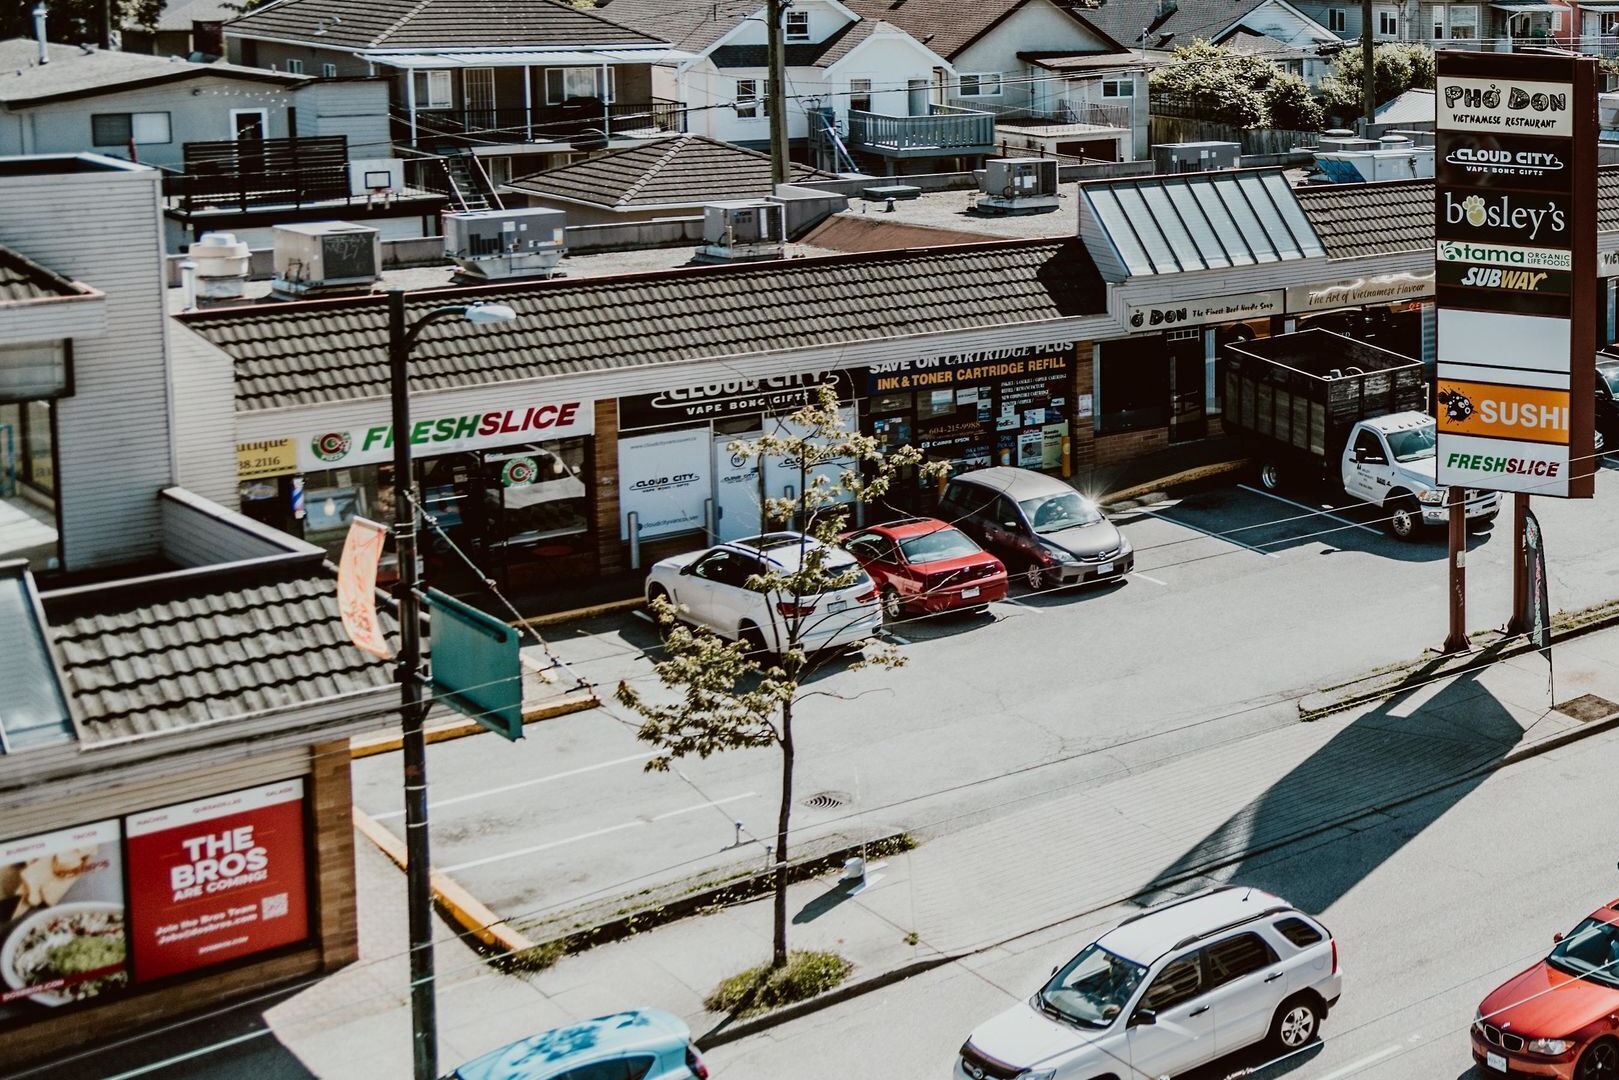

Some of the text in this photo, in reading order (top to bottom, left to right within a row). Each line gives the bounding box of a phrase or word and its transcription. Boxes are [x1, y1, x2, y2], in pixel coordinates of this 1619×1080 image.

[1507, 87, 1566, 112] DON
[1452, 114, 1557, 129] VIETNAMESE RESTAURANT
[1457, 149, 1554, 166] CLOUD CITY
[1466, 166, 1488, 174] VAPE
[1445, 192, 1566, 240] bosley's
[1464, 244, 1570, 264] tama ORGANIC
[1542, 259, 1570, 268] FOODS
[1461, 266, 1548, 291] SUBWAY
[1308, 293, 1324, 306] The
[1325, 291, 1341, 303] Art
[1352, 288, 1395, 300] Vietnamese
[1396, 283, 1426, 295] Flavour
[1149, 308, 1188, 326] DON
[877, 356, 1067, 391] INK & TONER CARTRIDGE REFILL
[686, 404, 722, 416] VAPE
[1480, 398, 1568, 431] SUSHI
[1447, 453, 1560, 477] FRESHSLICE
[636, 472, 695, 489] CLOUD CITY
[182, 825, 255, 862] THE
[171, 847, 269, 891] BROS
[173, 869, 268, 903] ARE COMING!
